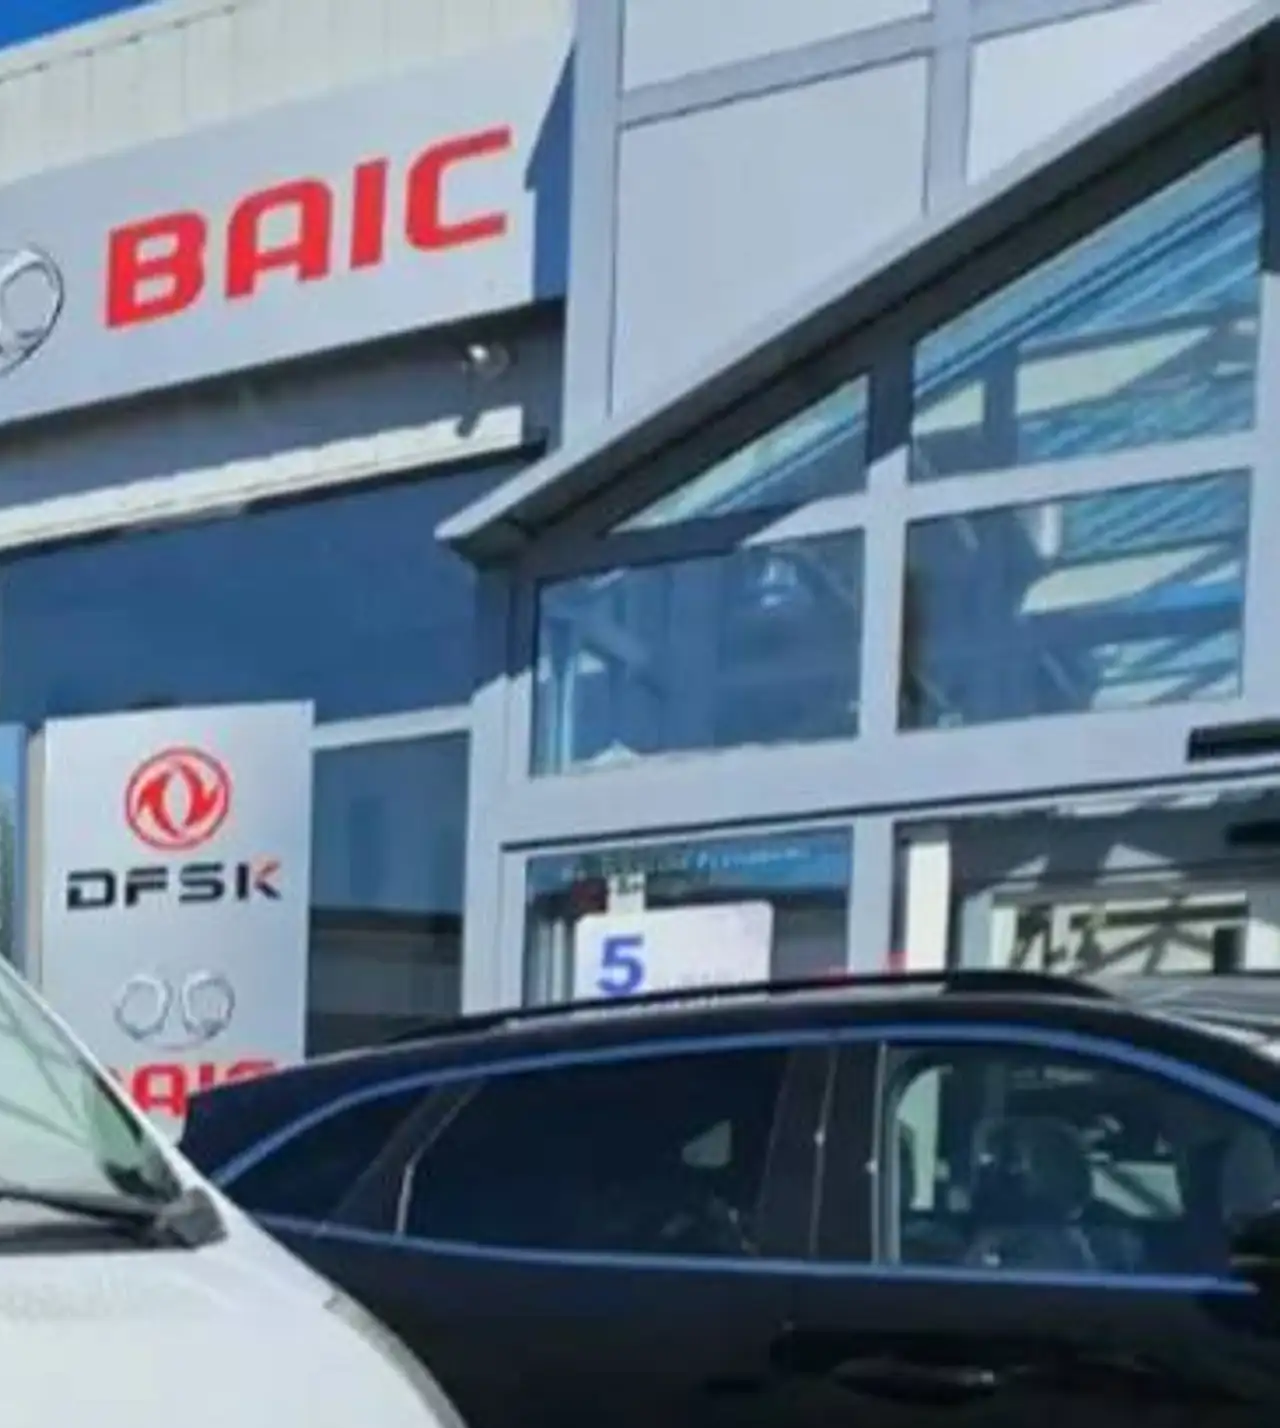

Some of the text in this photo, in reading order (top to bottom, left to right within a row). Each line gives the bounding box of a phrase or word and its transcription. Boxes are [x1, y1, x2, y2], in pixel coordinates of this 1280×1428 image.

[104, 125, 513, 329] BAIC
[66, 860, 283, 911] DFSK
[595, 934, 645, 996] 5
